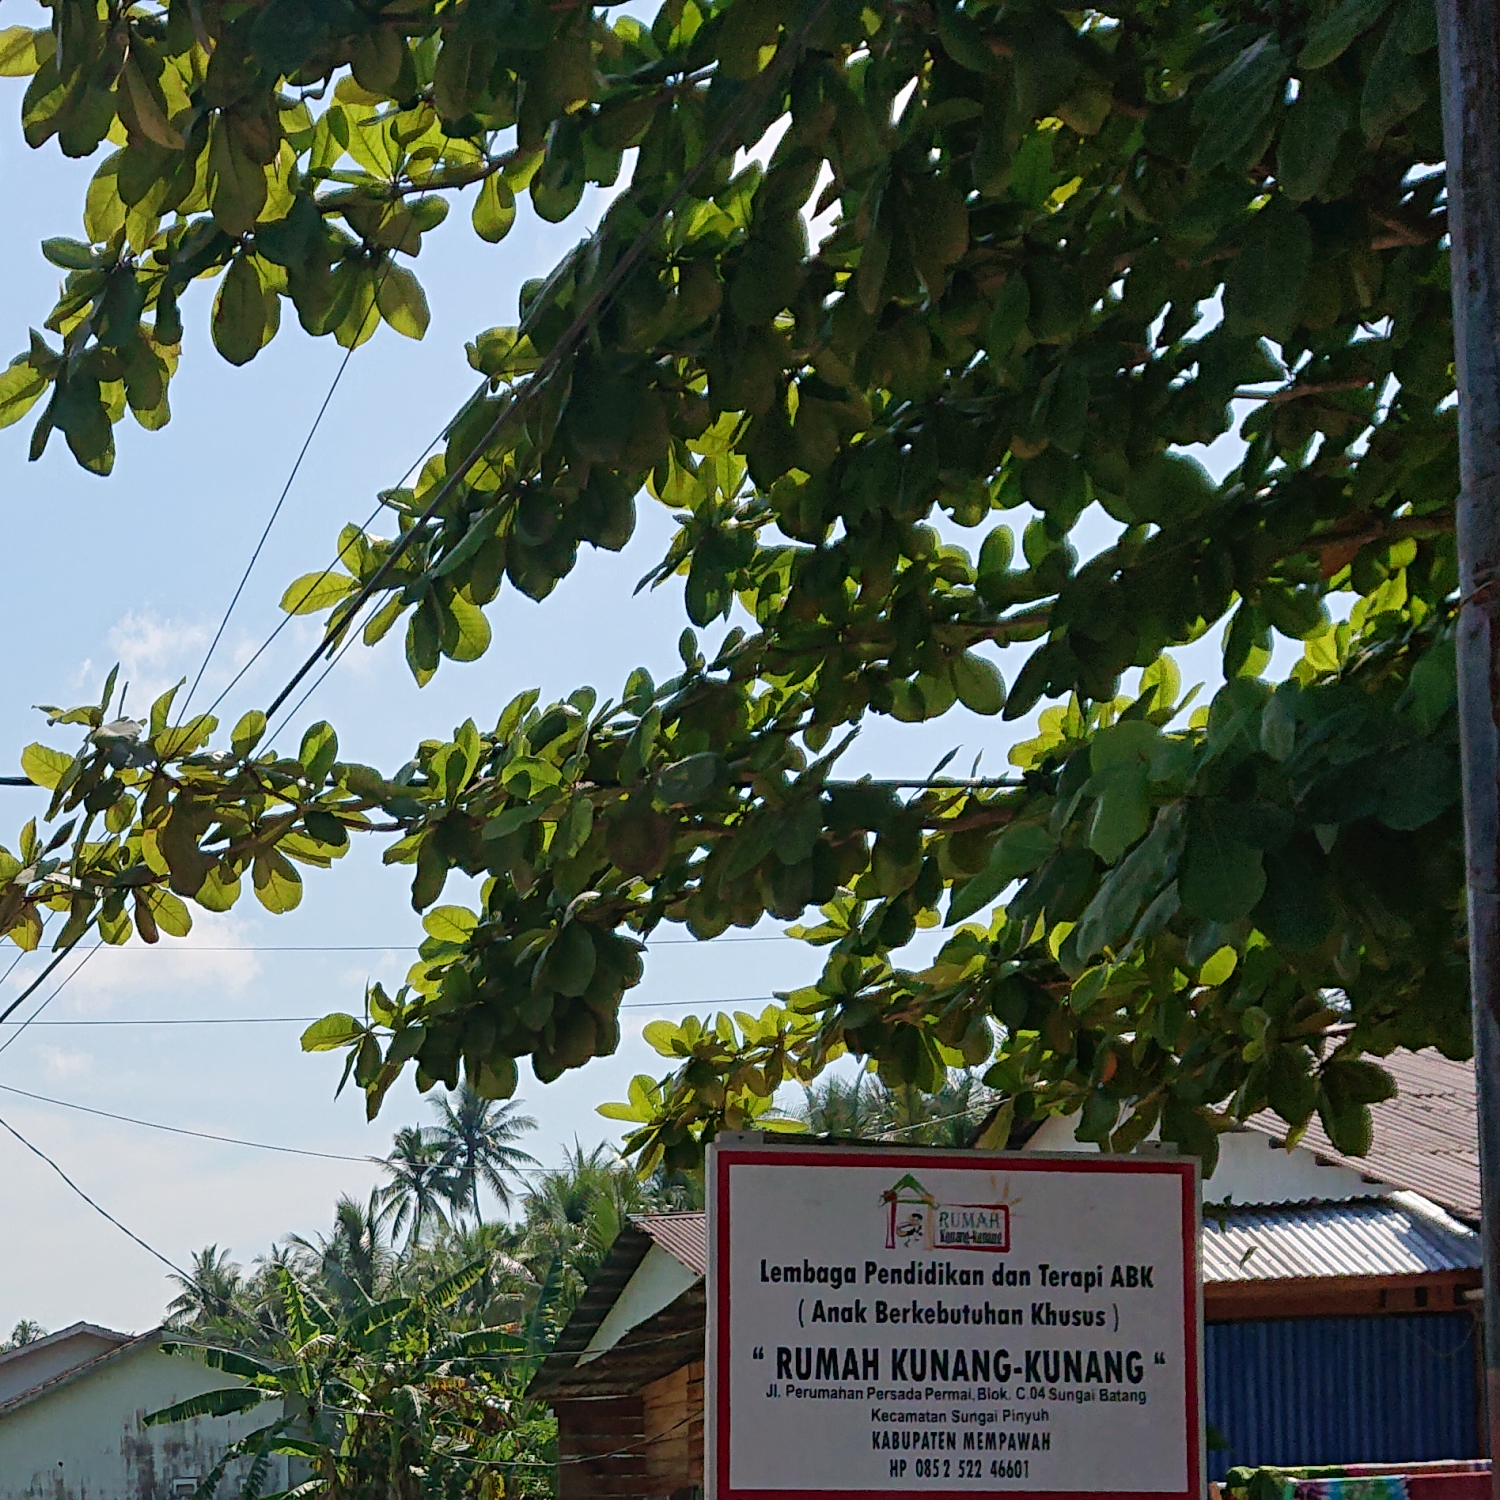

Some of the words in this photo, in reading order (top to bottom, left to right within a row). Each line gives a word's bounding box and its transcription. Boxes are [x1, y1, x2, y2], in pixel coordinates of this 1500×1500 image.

[939, 1211, 1000, 1229] RUMAH
[760, 1258, 857, 1290] Lembaga
[864, 1260, 985, 1286] Pendidikan
[992, 1262, 1031, 1287] dan
[1038, 1263, 1104, 1293] Terapi
[1110, 1264, 1155, 1288] ABK
[811, 1299, 868, 1324] Anak
[875, 1299, 1024, 1326] Berkebutuhan
[1031, 1302, 1106, 1327] Khusus
[776, 1346, 879, 1381] RUMAH
[891, 1347, 1145, 1384] KUNANG-KUNANG
[765, 1383, 781, 1398] Jl.
[785, 1384, 864, 1400] Perumahan
[866, 1386, 922, 1401] Persada
[1049, 1387, 1096, 1405] Sungai
[1099, 1388, 1147, 1405] Batang
[871, 1407, 947, 1423] Kecamatan
[951, 1409, 998, 1426] Sungai
[1002, 1408, 1049, 1425] Pinyuh
[872, 1430, 957, 1450] KABUPATEN
[963, 1431, 1051, 1451] MEMPAWAH
[889, 1458, 907, 1478] HP
[958, 1459, 982, 1479] 522
[990, 1459, 1030, 1479] 46601
